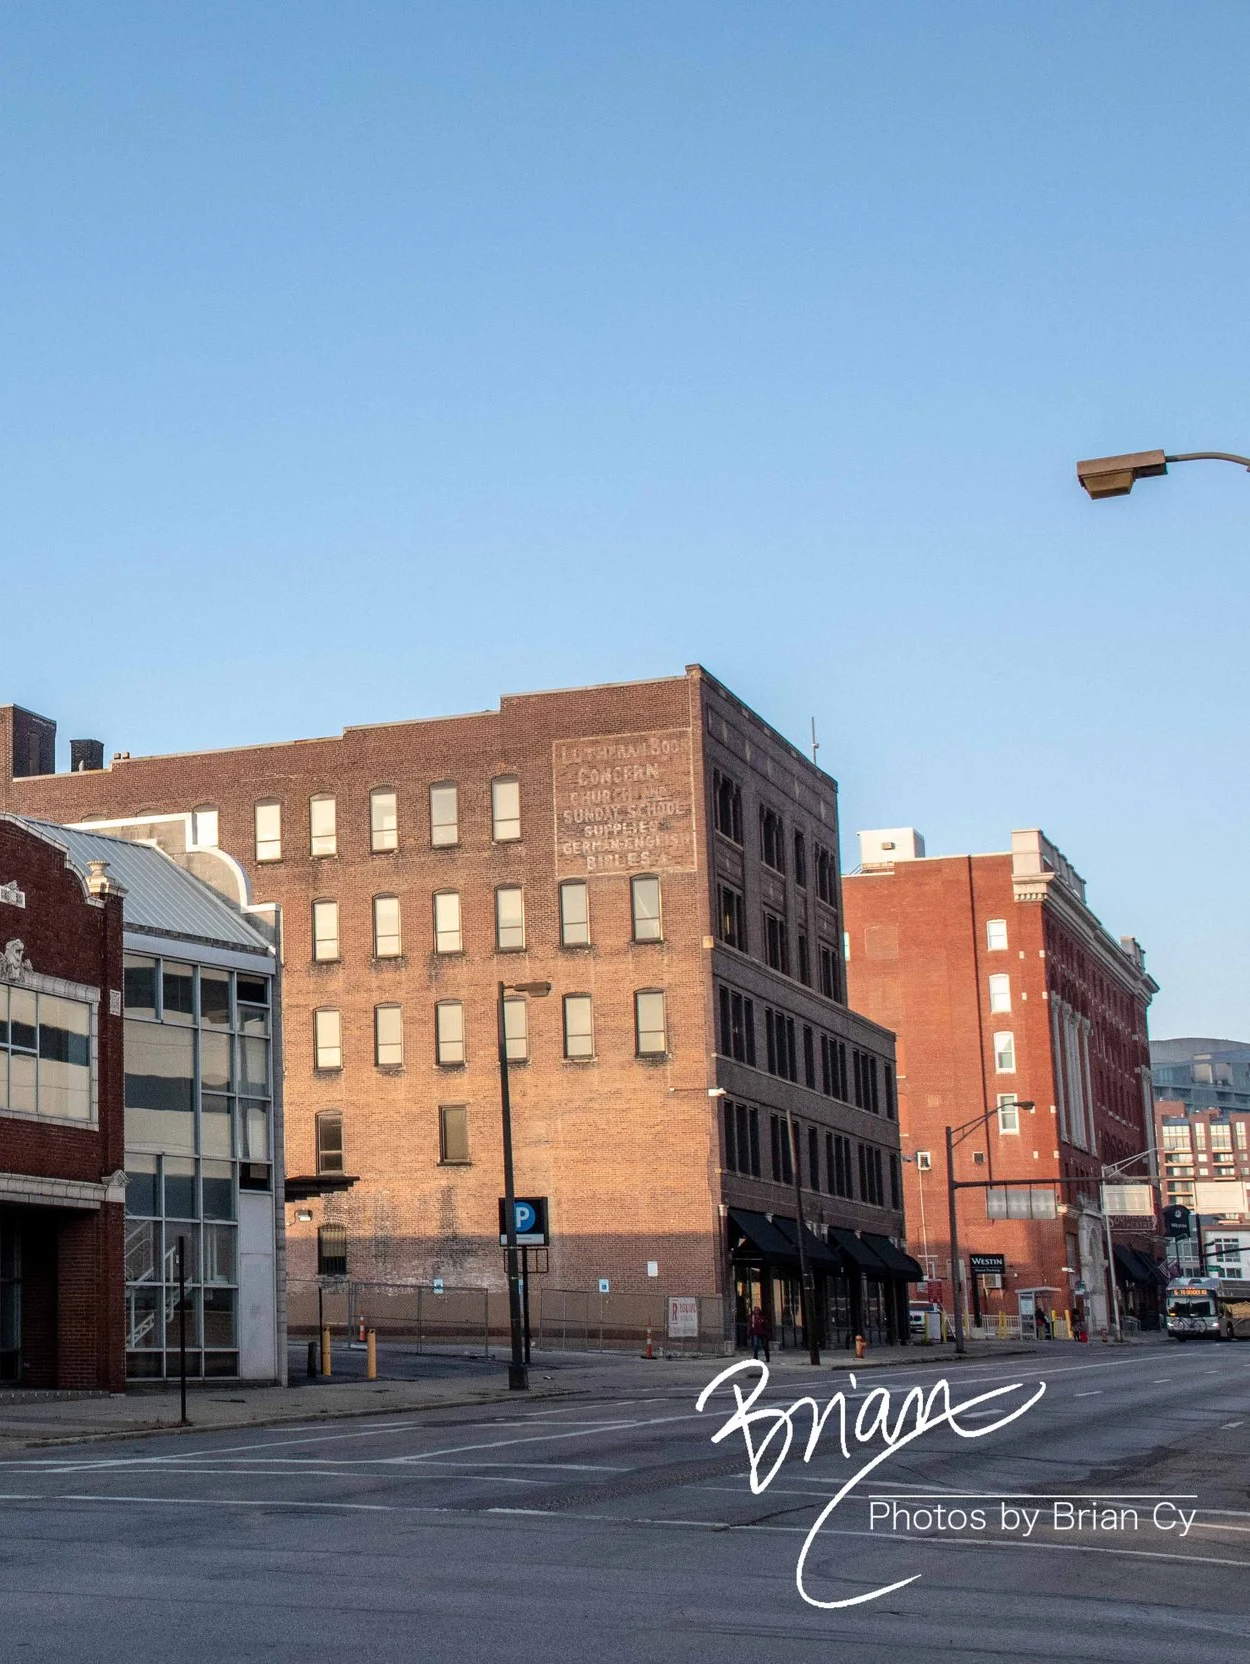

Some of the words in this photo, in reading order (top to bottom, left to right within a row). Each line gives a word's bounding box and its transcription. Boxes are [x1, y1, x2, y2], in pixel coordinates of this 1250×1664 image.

[578, 763, 659, 786] CONCERN
[563, 805, 619, 824] SUNDAY
[628, 801, 686, 819] SCHOOL
[584, 820, 658, 838] SUPPLIES
[586, 851, 650, 870] BIBLES
[515, 1207, 530, 1228] P
[971, 1257, 1003, 1266] WESTIN
